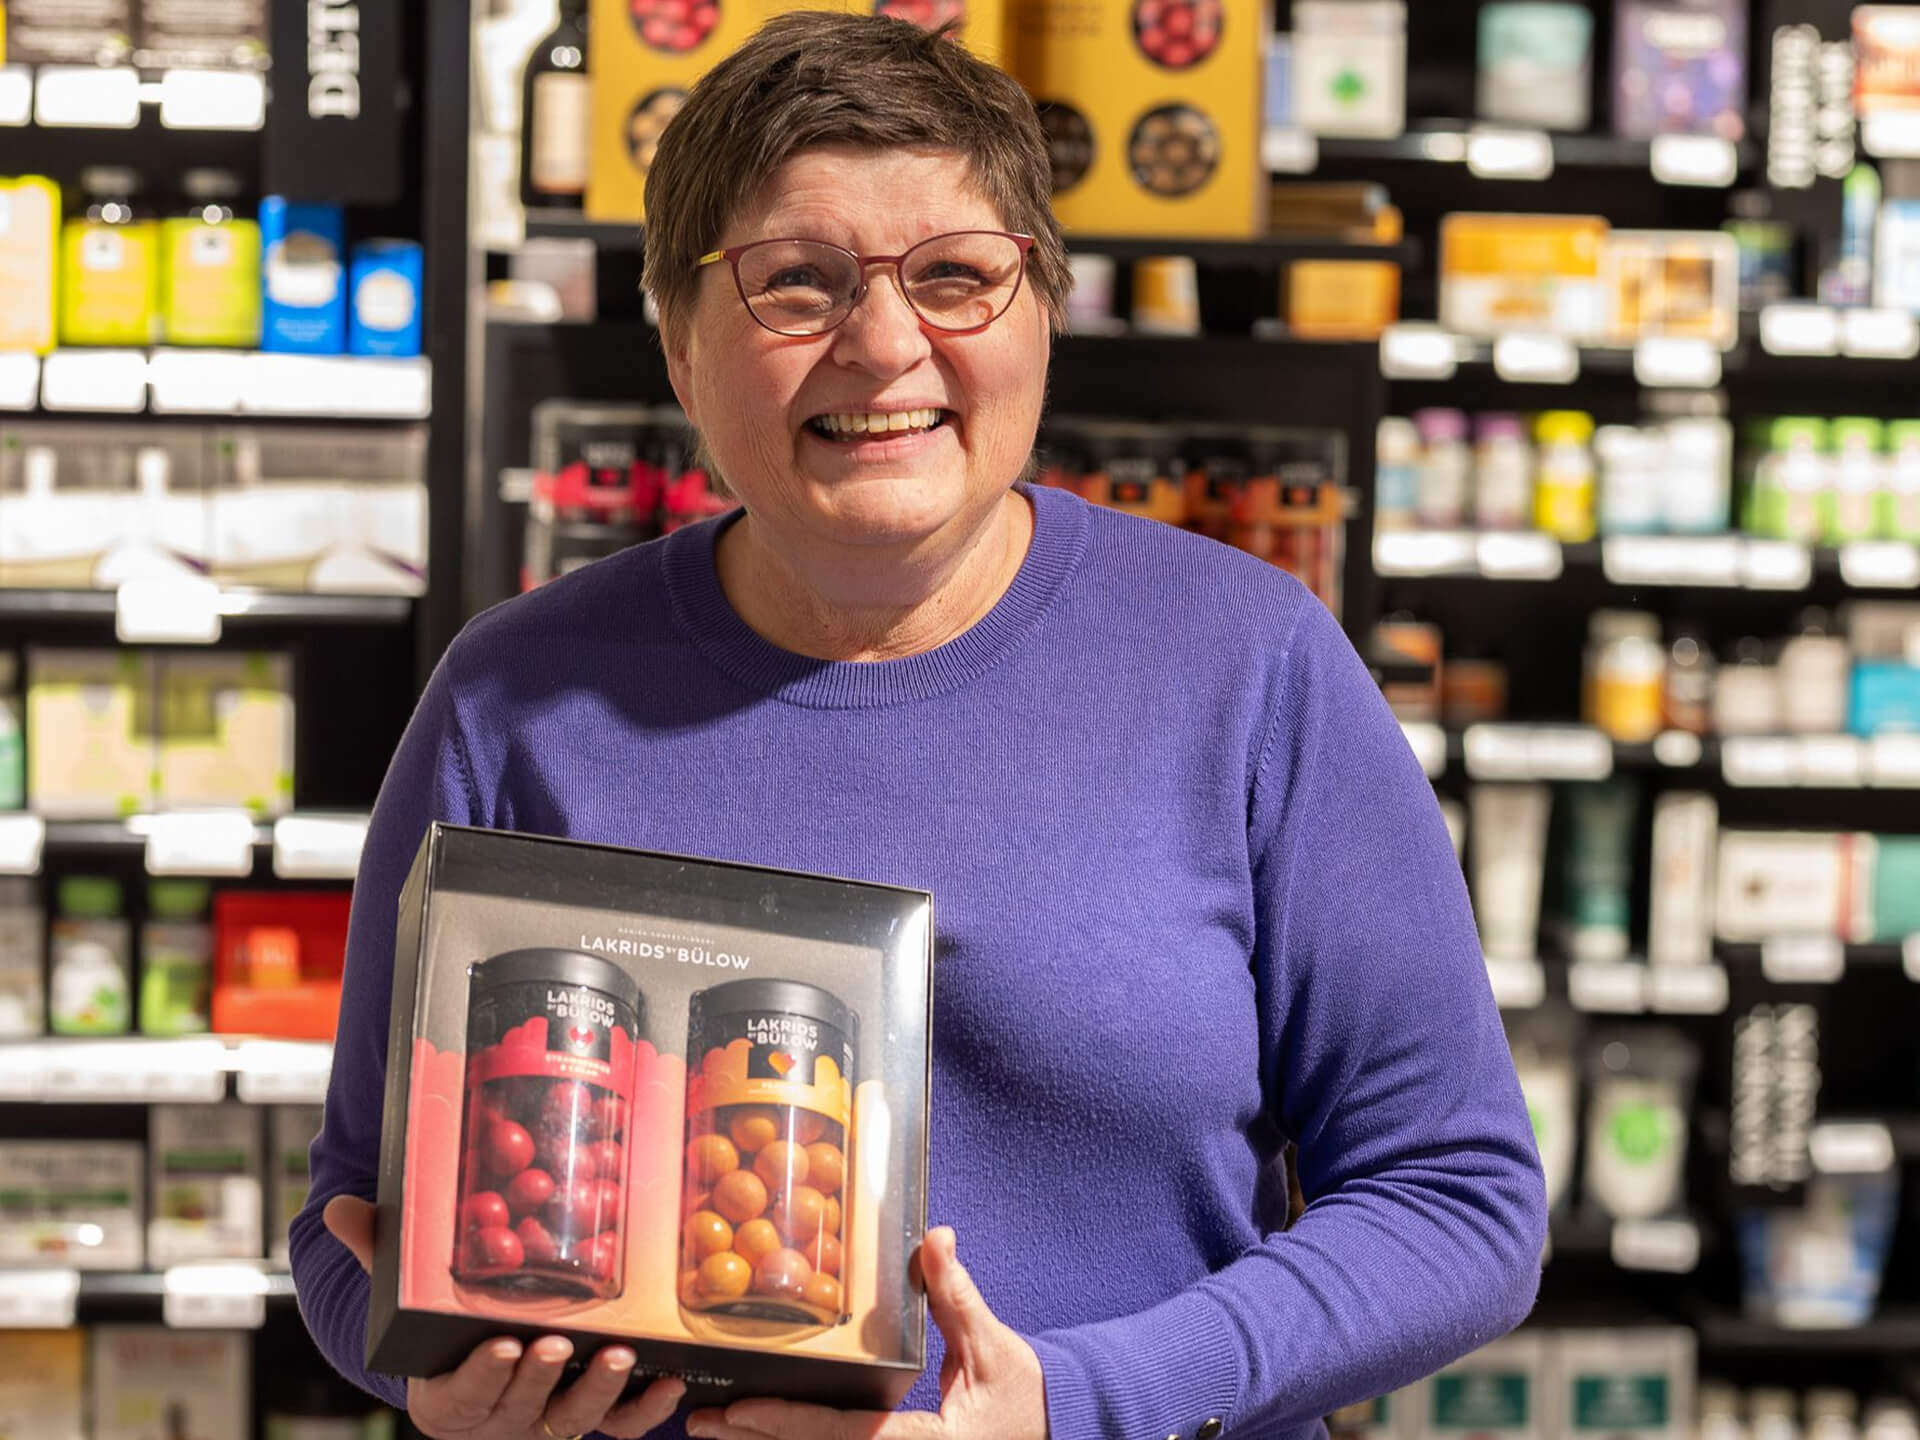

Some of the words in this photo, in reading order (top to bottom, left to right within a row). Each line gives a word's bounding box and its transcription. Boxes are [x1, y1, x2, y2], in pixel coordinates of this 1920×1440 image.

[307, 0, 360, 119] DET
[580, 935, 665, 960] LAKRIDS
[677, 946, 750, 970] BÜLOW
[547, 989, 615, 1016] LAKRIDS
[747, 1018, 818, 1038] LAKRIDS
[756, 1031, 818, 1051] BÜLOW
